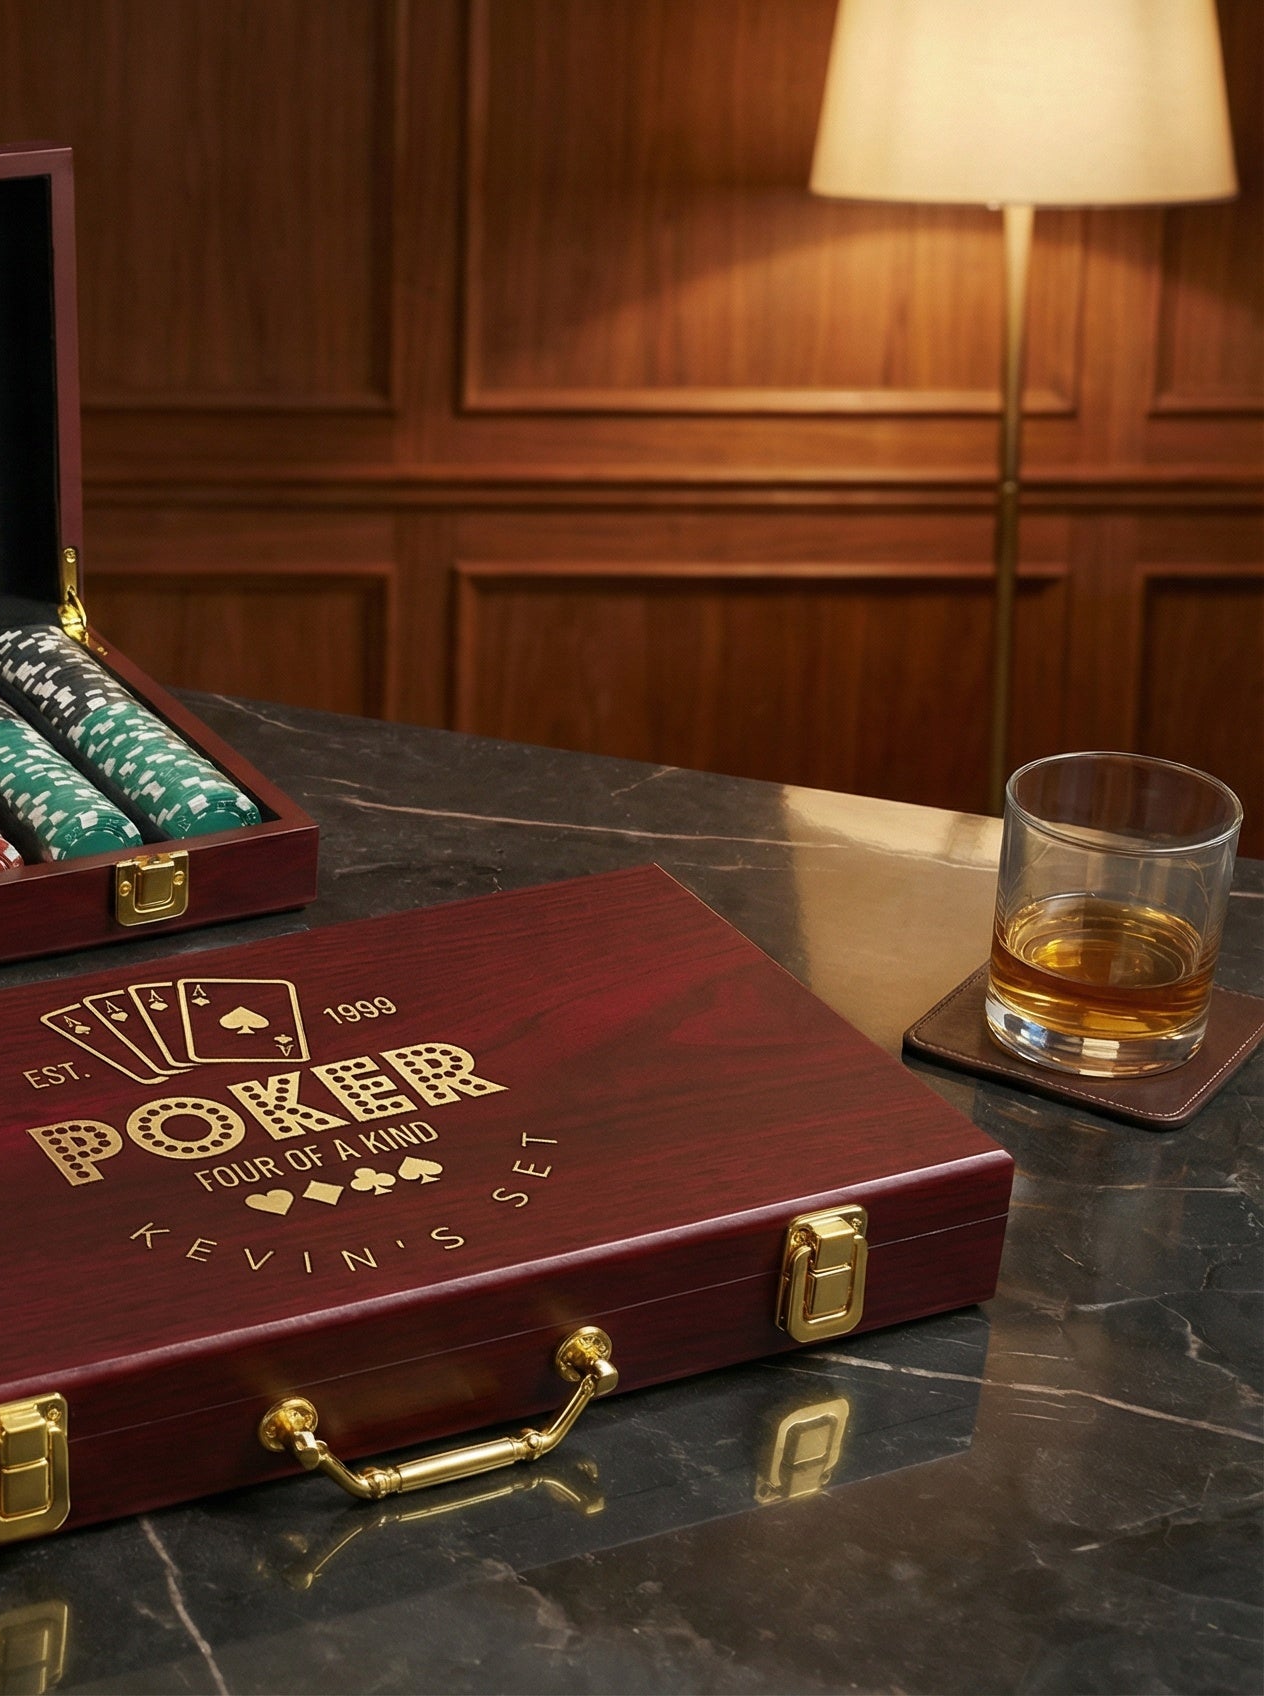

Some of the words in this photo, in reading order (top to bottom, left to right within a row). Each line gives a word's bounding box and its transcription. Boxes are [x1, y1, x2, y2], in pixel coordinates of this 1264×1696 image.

[22, 1061, 91, 1089] EST.
[322, 996, 398, 1025] 1999
[26, 1042, 510, 1187] POKER
[193, 1156, 285, 1192] FOUR
[284, 1144, 324, 1172] OF
[337, 1139, 362, 1161] A
[358, 1121, 439, 1155] KIND
[129, 1222, 465, 1275] KEVIN'S
[492, 1131, 559, 1208] SET
